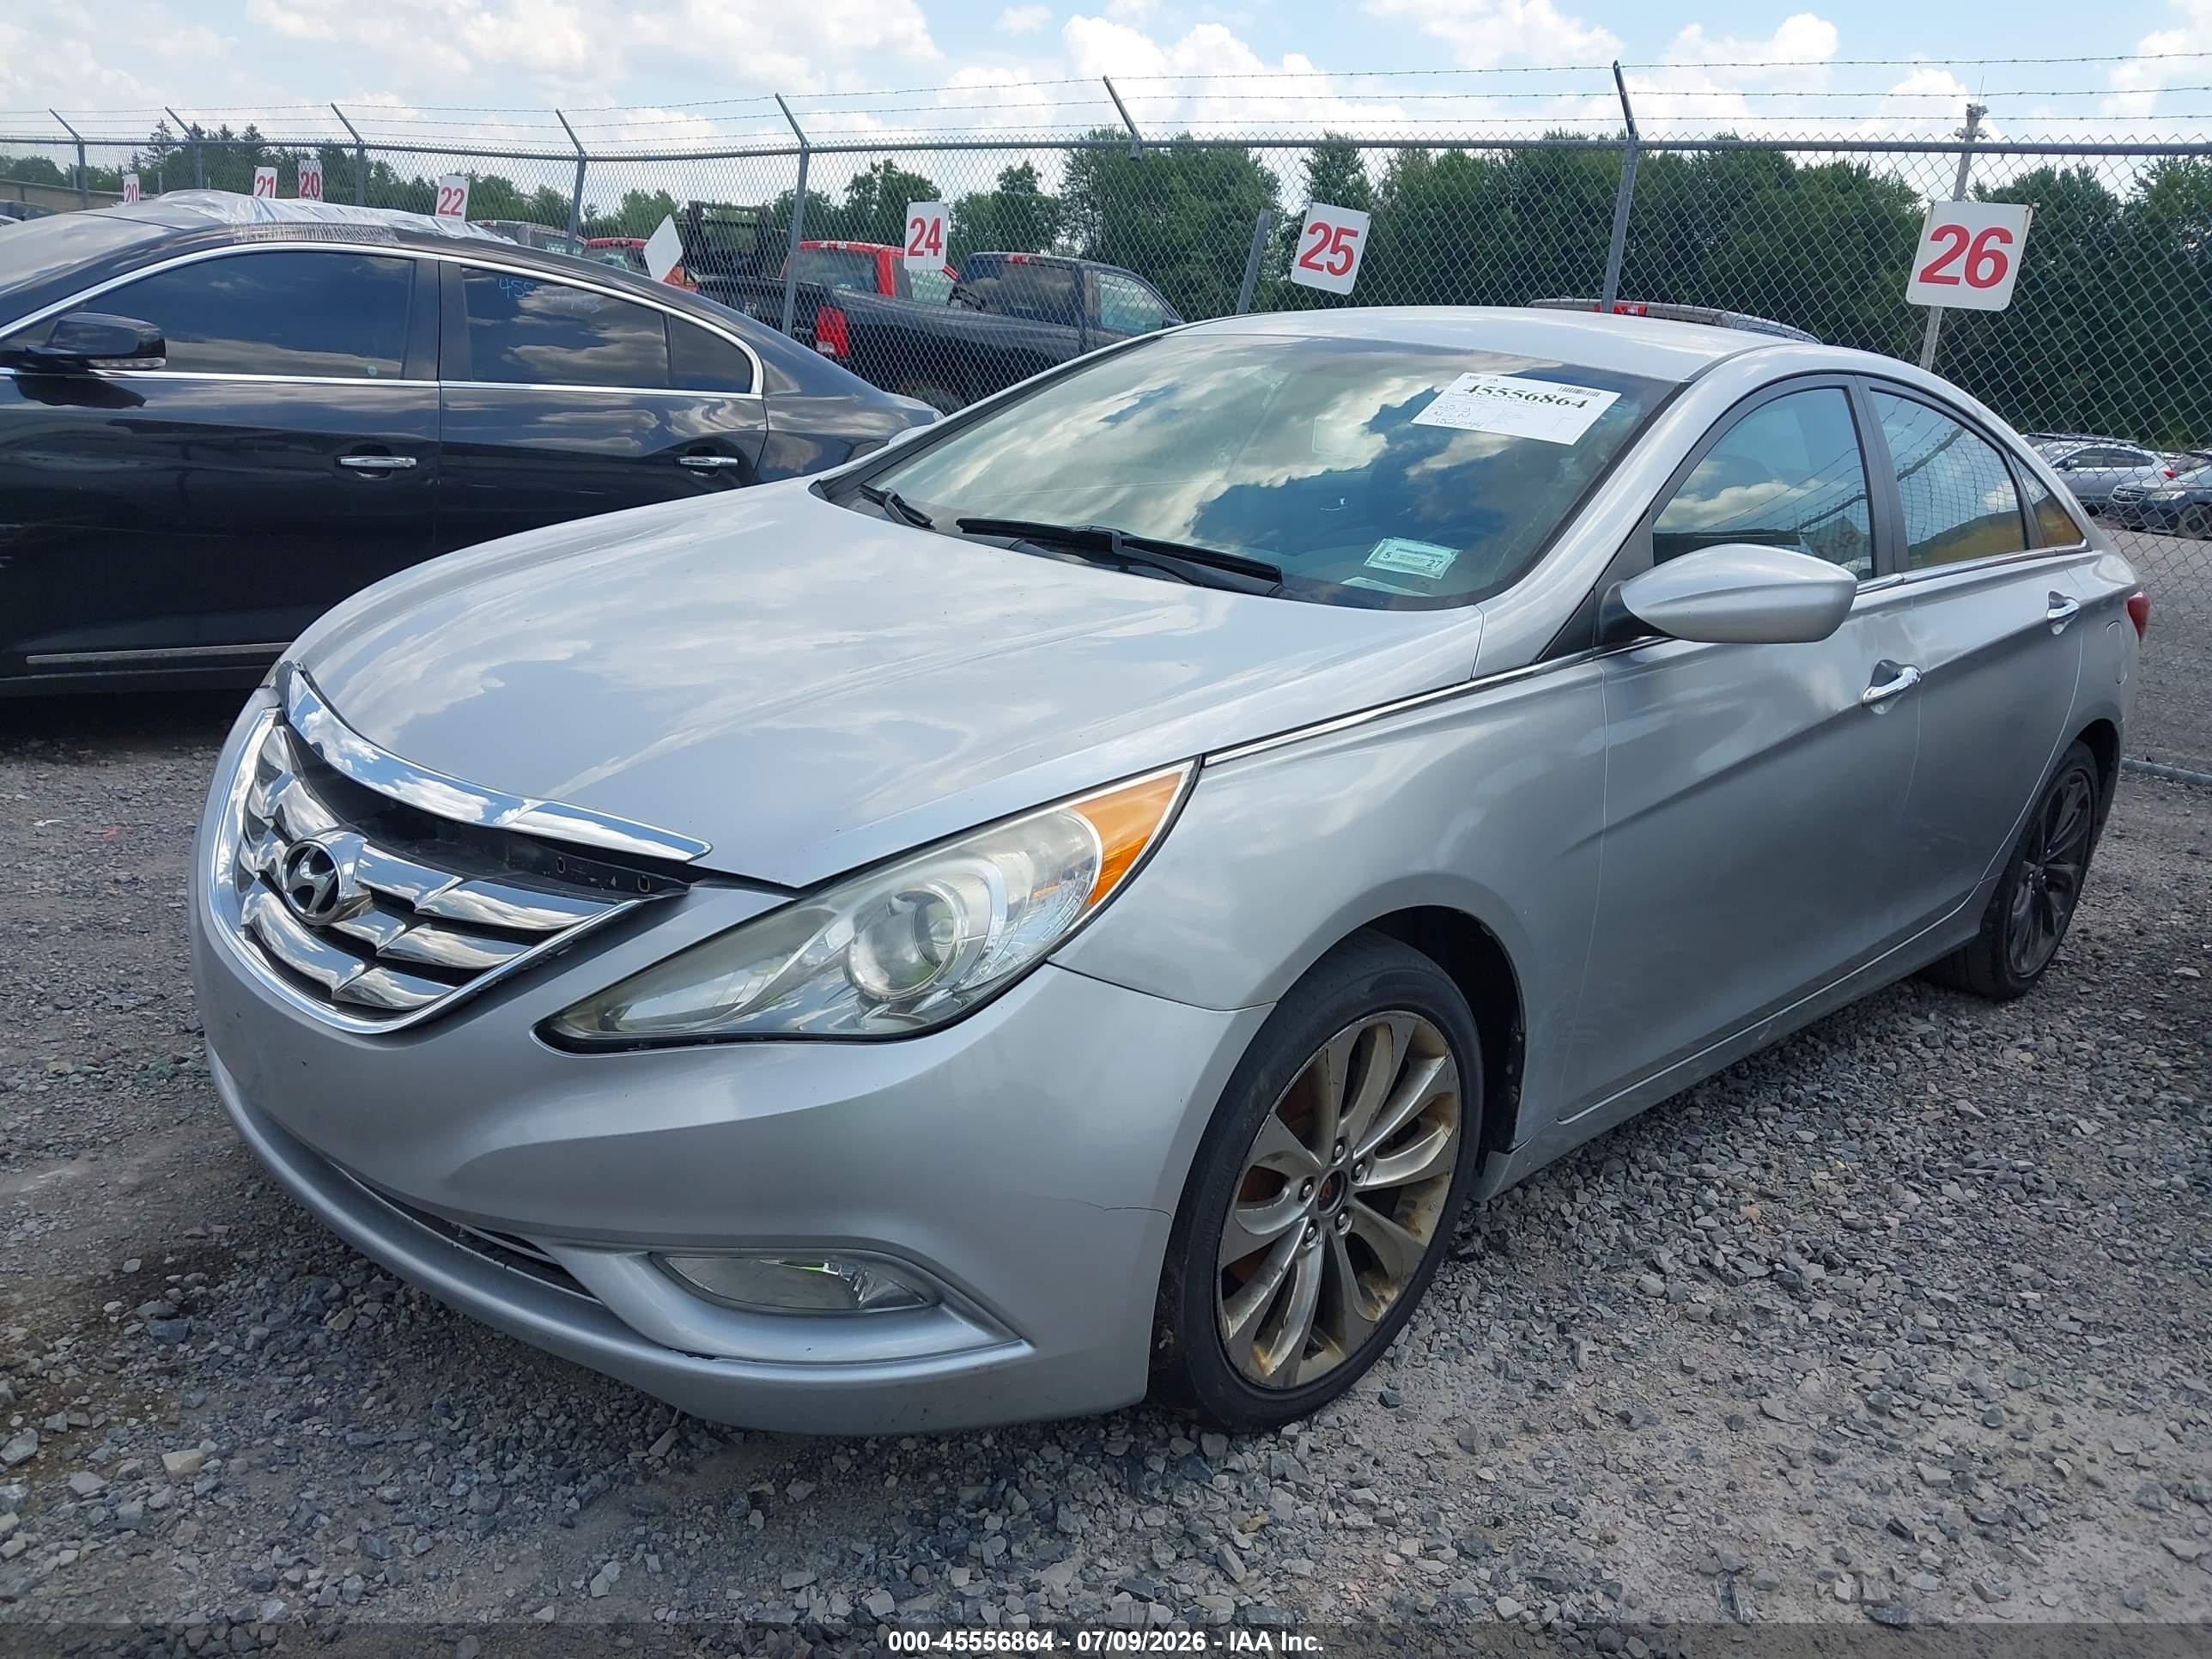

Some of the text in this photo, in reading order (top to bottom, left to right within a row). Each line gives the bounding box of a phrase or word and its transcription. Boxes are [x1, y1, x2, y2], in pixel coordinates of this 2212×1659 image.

[125, 184, 137, 203] 20
[257, 175, 275, 198] 21
[301, 171, 320, 198] 20
[438, 185, 465, 216] 22
[908, 217, 943, 257] 24
[1298, 222, 1359, 276] 25
[1917, 223, 2014, 289] 26
[1463, 384, 1589, 409] 45556864
[1426, 559, 1443, 568] 27
